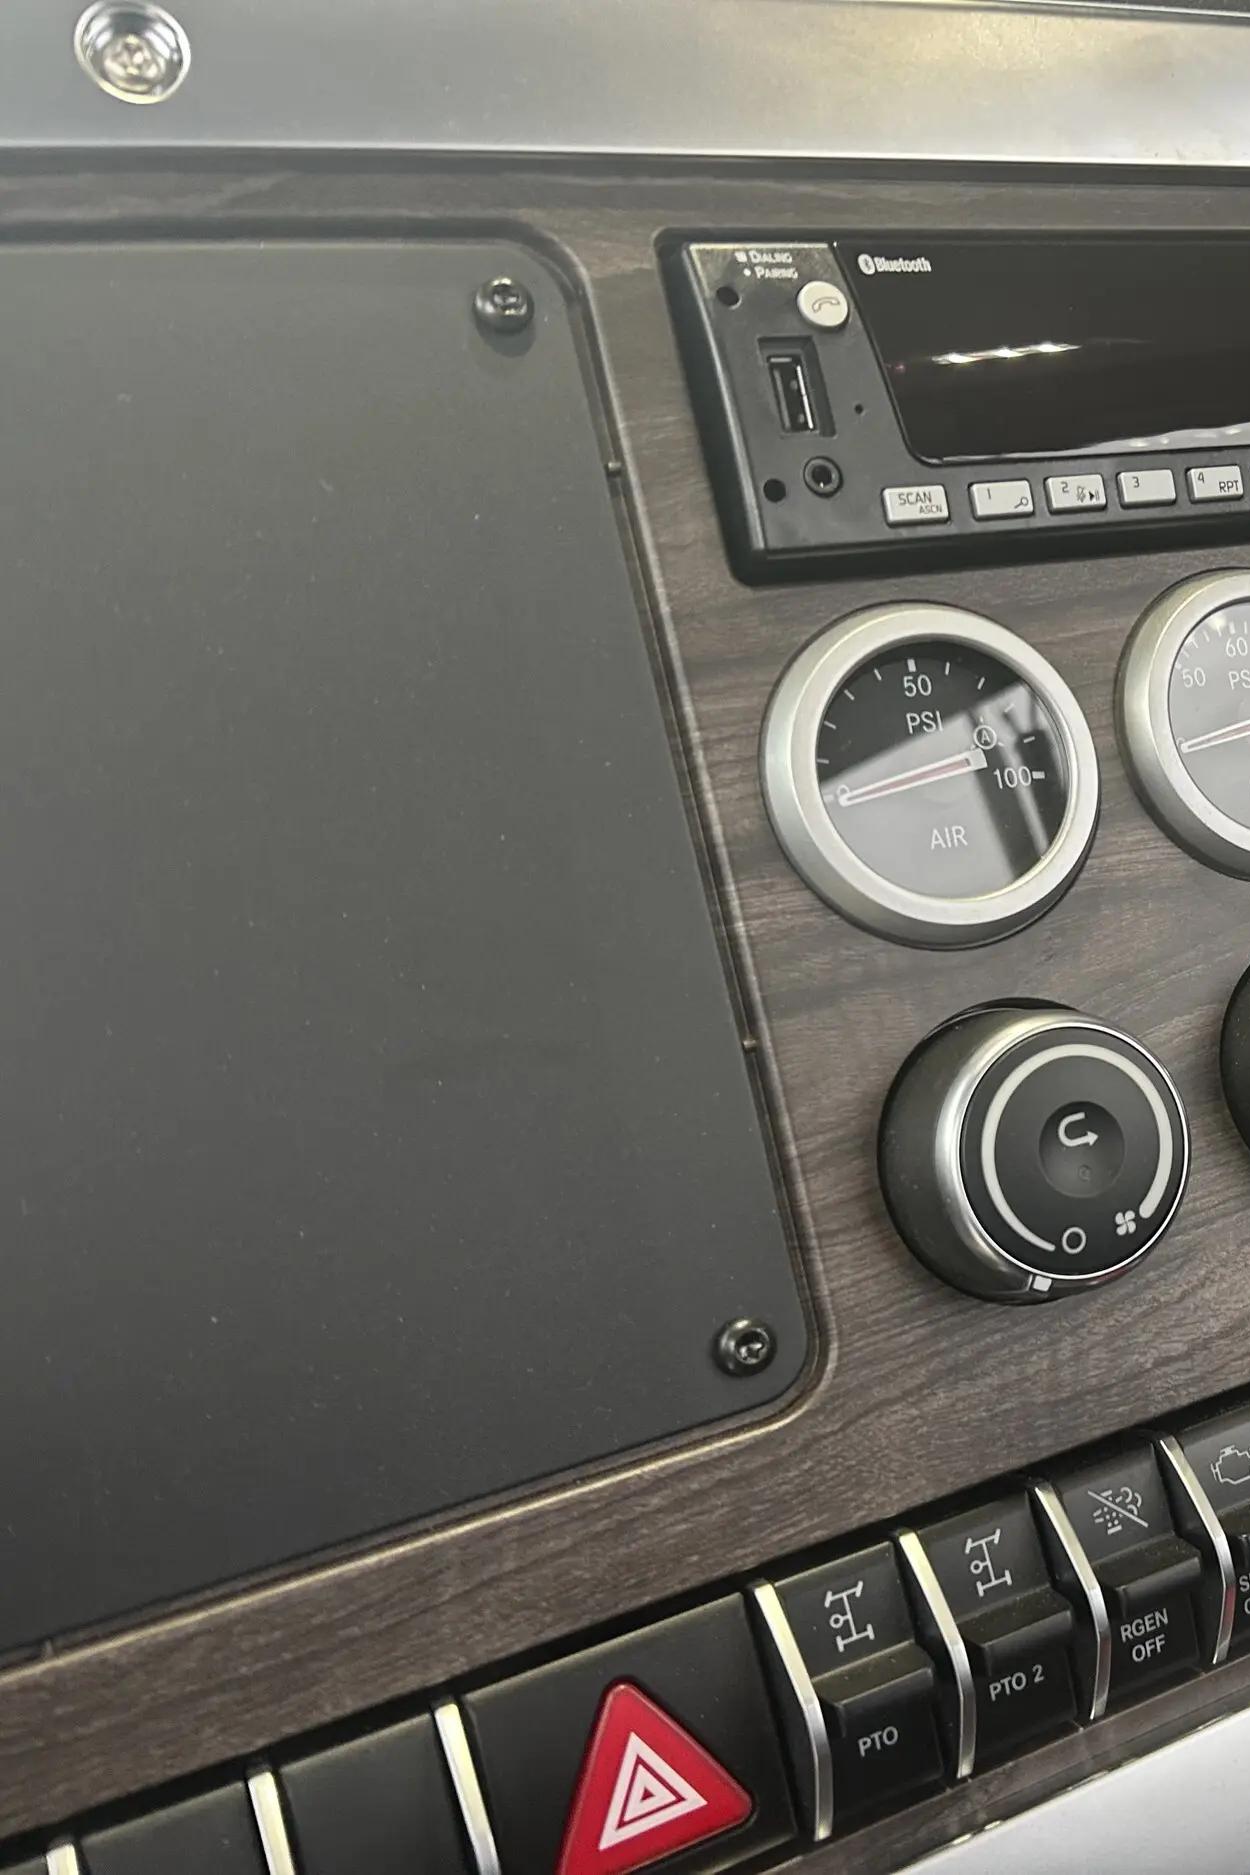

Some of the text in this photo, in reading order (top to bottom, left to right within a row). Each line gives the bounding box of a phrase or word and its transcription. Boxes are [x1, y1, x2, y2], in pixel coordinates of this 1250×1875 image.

[874, 256, 932, 273] Bluetooth
[1061, 481, 1070, 493] 2
[1132, 477, 1140, 489] 3
[1196, 471, 1205, 484] 4
[1218, 480, 1240, 494] RPT
[898, 490, 933, 506] SCAN
[918, 504, 943, 515] ASCN
[1225, 636, 1248, 658] 60
[903, 674, 933, 698] 50
[1182, 667, 1206, 689] 50
[905, 710, 944, 734] PSI
[994, 766, 1032, 790] 100
[930, 825, 968, 850] AIR
[1119, 1608, 1169, 1643] RGEN
[1131, 1636, 1168, 1664] OFF
[988, 1663, 1046, 1703] PTO 2
[857, 1725, 900, 1758] PTO
